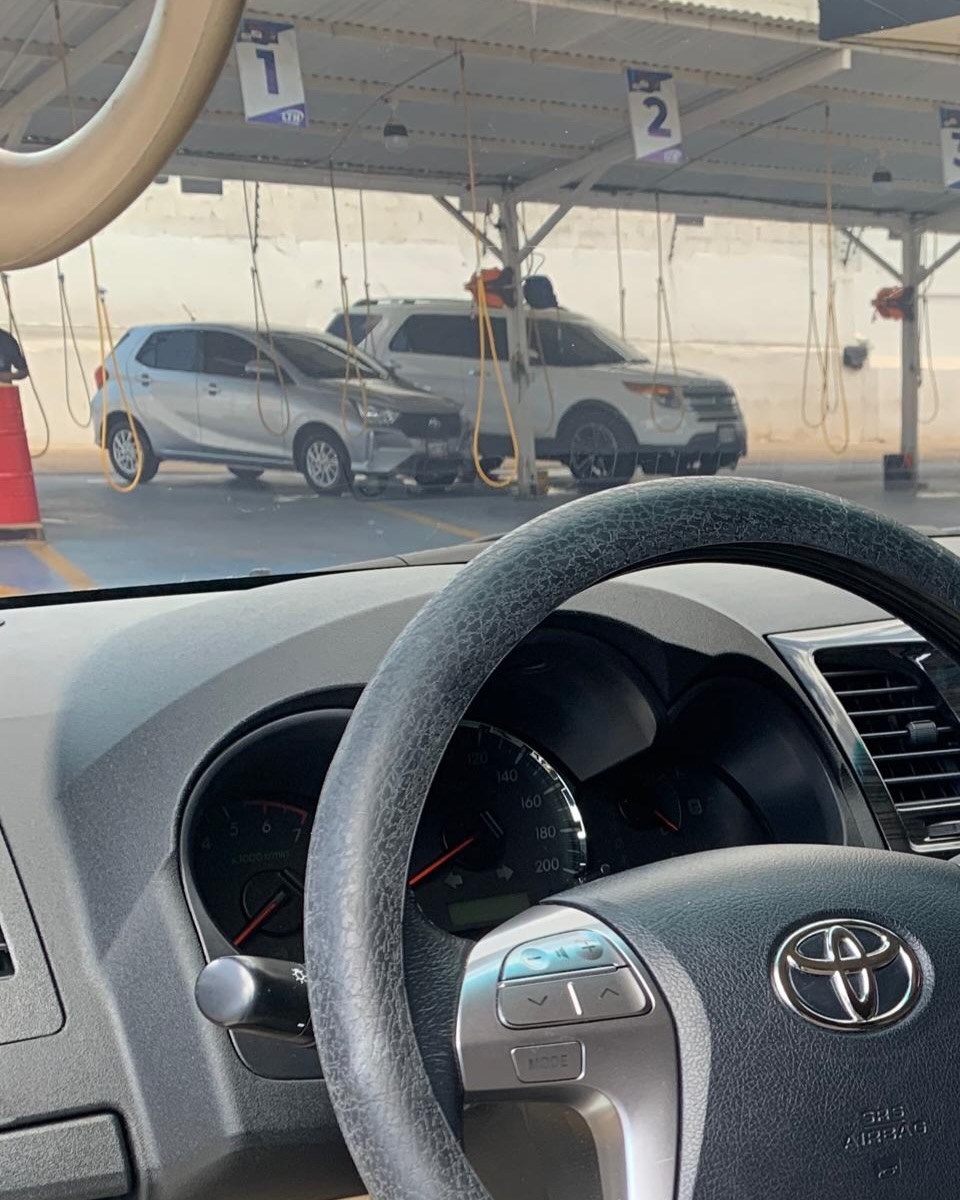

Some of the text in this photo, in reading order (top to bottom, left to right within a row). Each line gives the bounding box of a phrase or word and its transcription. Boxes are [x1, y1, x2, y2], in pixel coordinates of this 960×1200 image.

[255, 48, 279, 95] 1
[643, 96, 671, 138] 2
[496, 768, 519, 783] 140
[520, 794, 543, 810] 160
[230, 821, 239, 837] 5
[261, 820, 273, 834] 6
[292, 827, 302, 844] 7
[535, 825, 557, 841] 180
[535, 857, 560, 874] 200
[528, 1054, 569, 1071] MODE
[863, 1106, 905, 1123] SRS
[844, 1121, 928, 1150] AIRBAG
